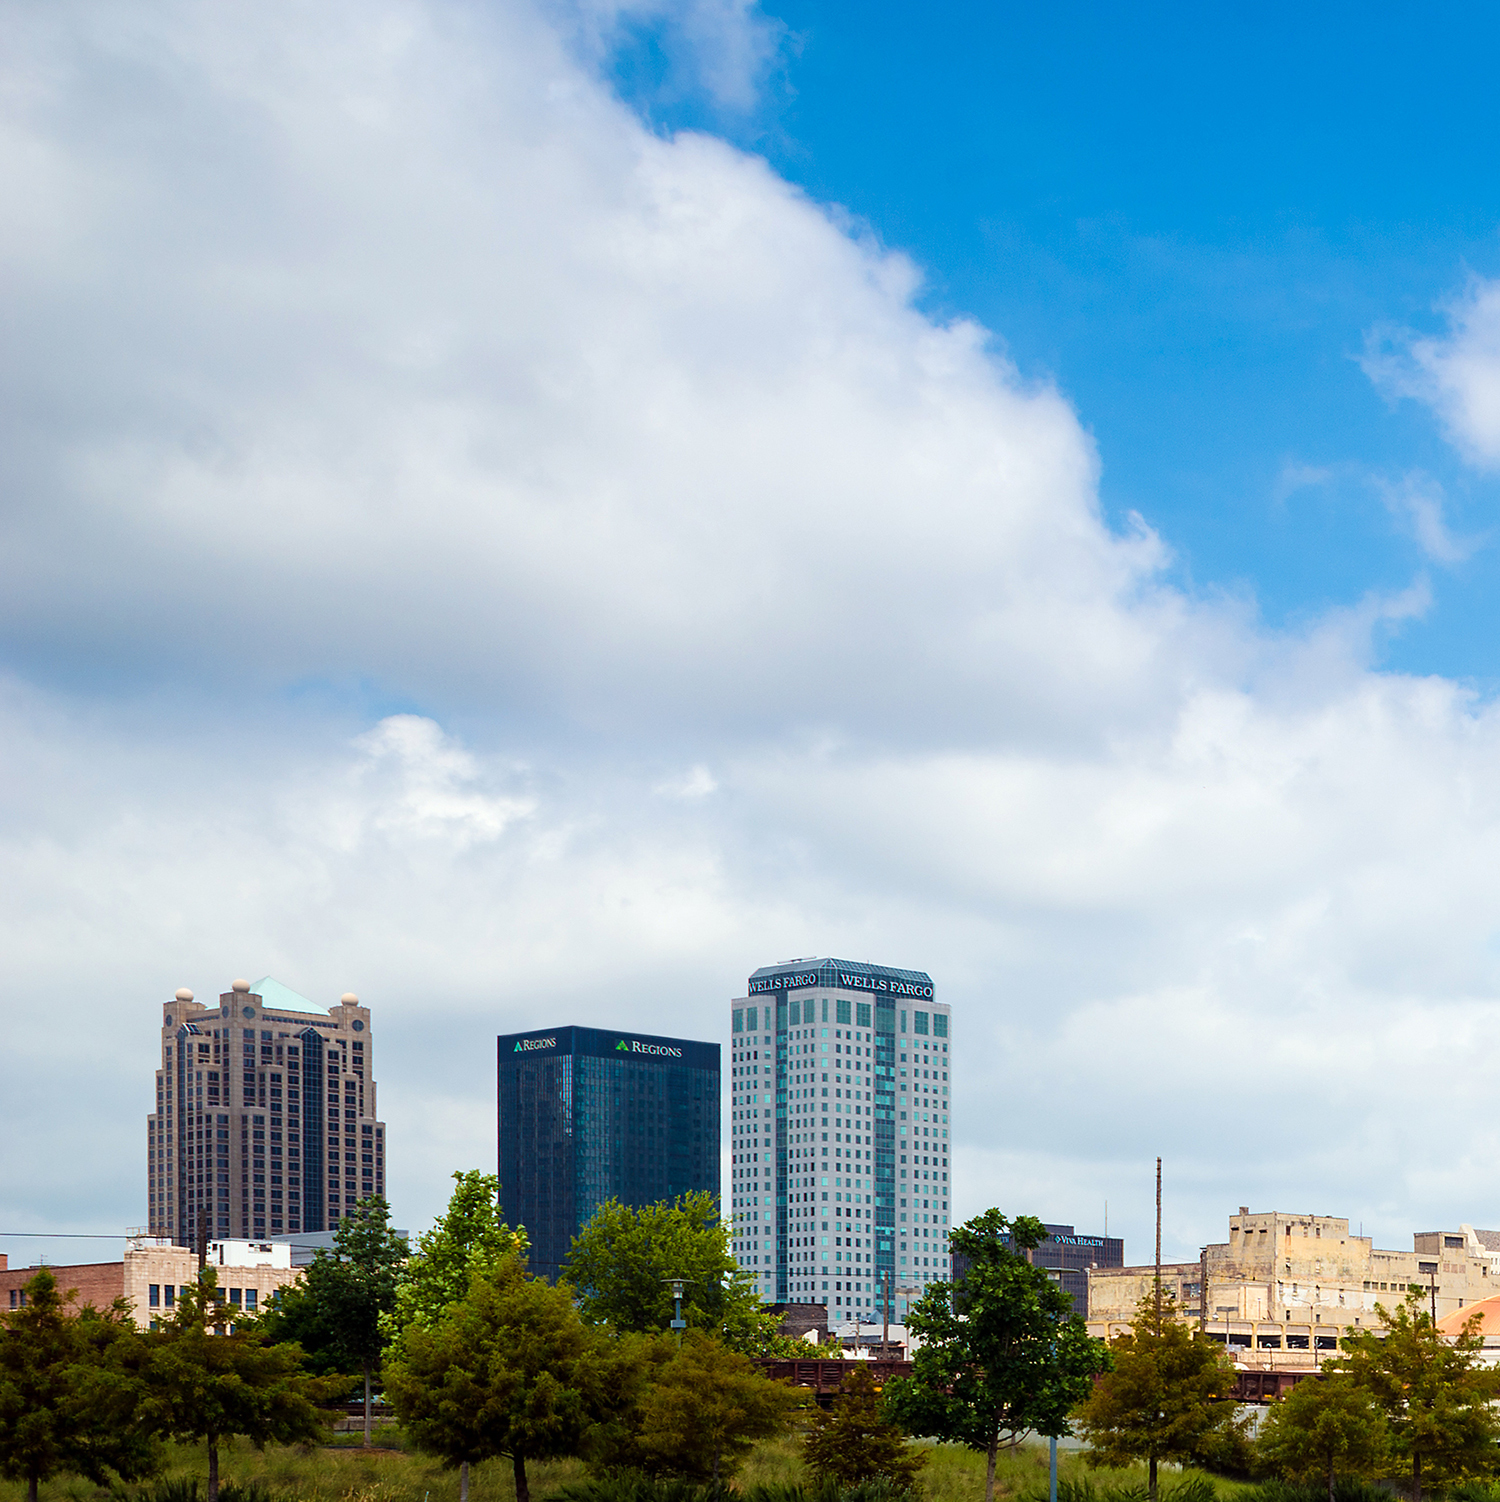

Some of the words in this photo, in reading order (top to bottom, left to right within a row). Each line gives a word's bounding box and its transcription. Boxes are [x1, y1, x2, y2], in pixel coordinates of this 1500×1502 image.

[750, 978, 782, 993] WELLS
[783, 974, 816, 988] FARGO
[840, 974, 887, 991] WELLS
[889, 982, 933, 998] FARGO
[523, 1037, 557, 1051] REGIONS
[632, 1040, 683, 1058] REGIONS
[1060, 1235, 1076, 1245] VIVA
[1077, 1237, 1104, 1247] HEALTH
